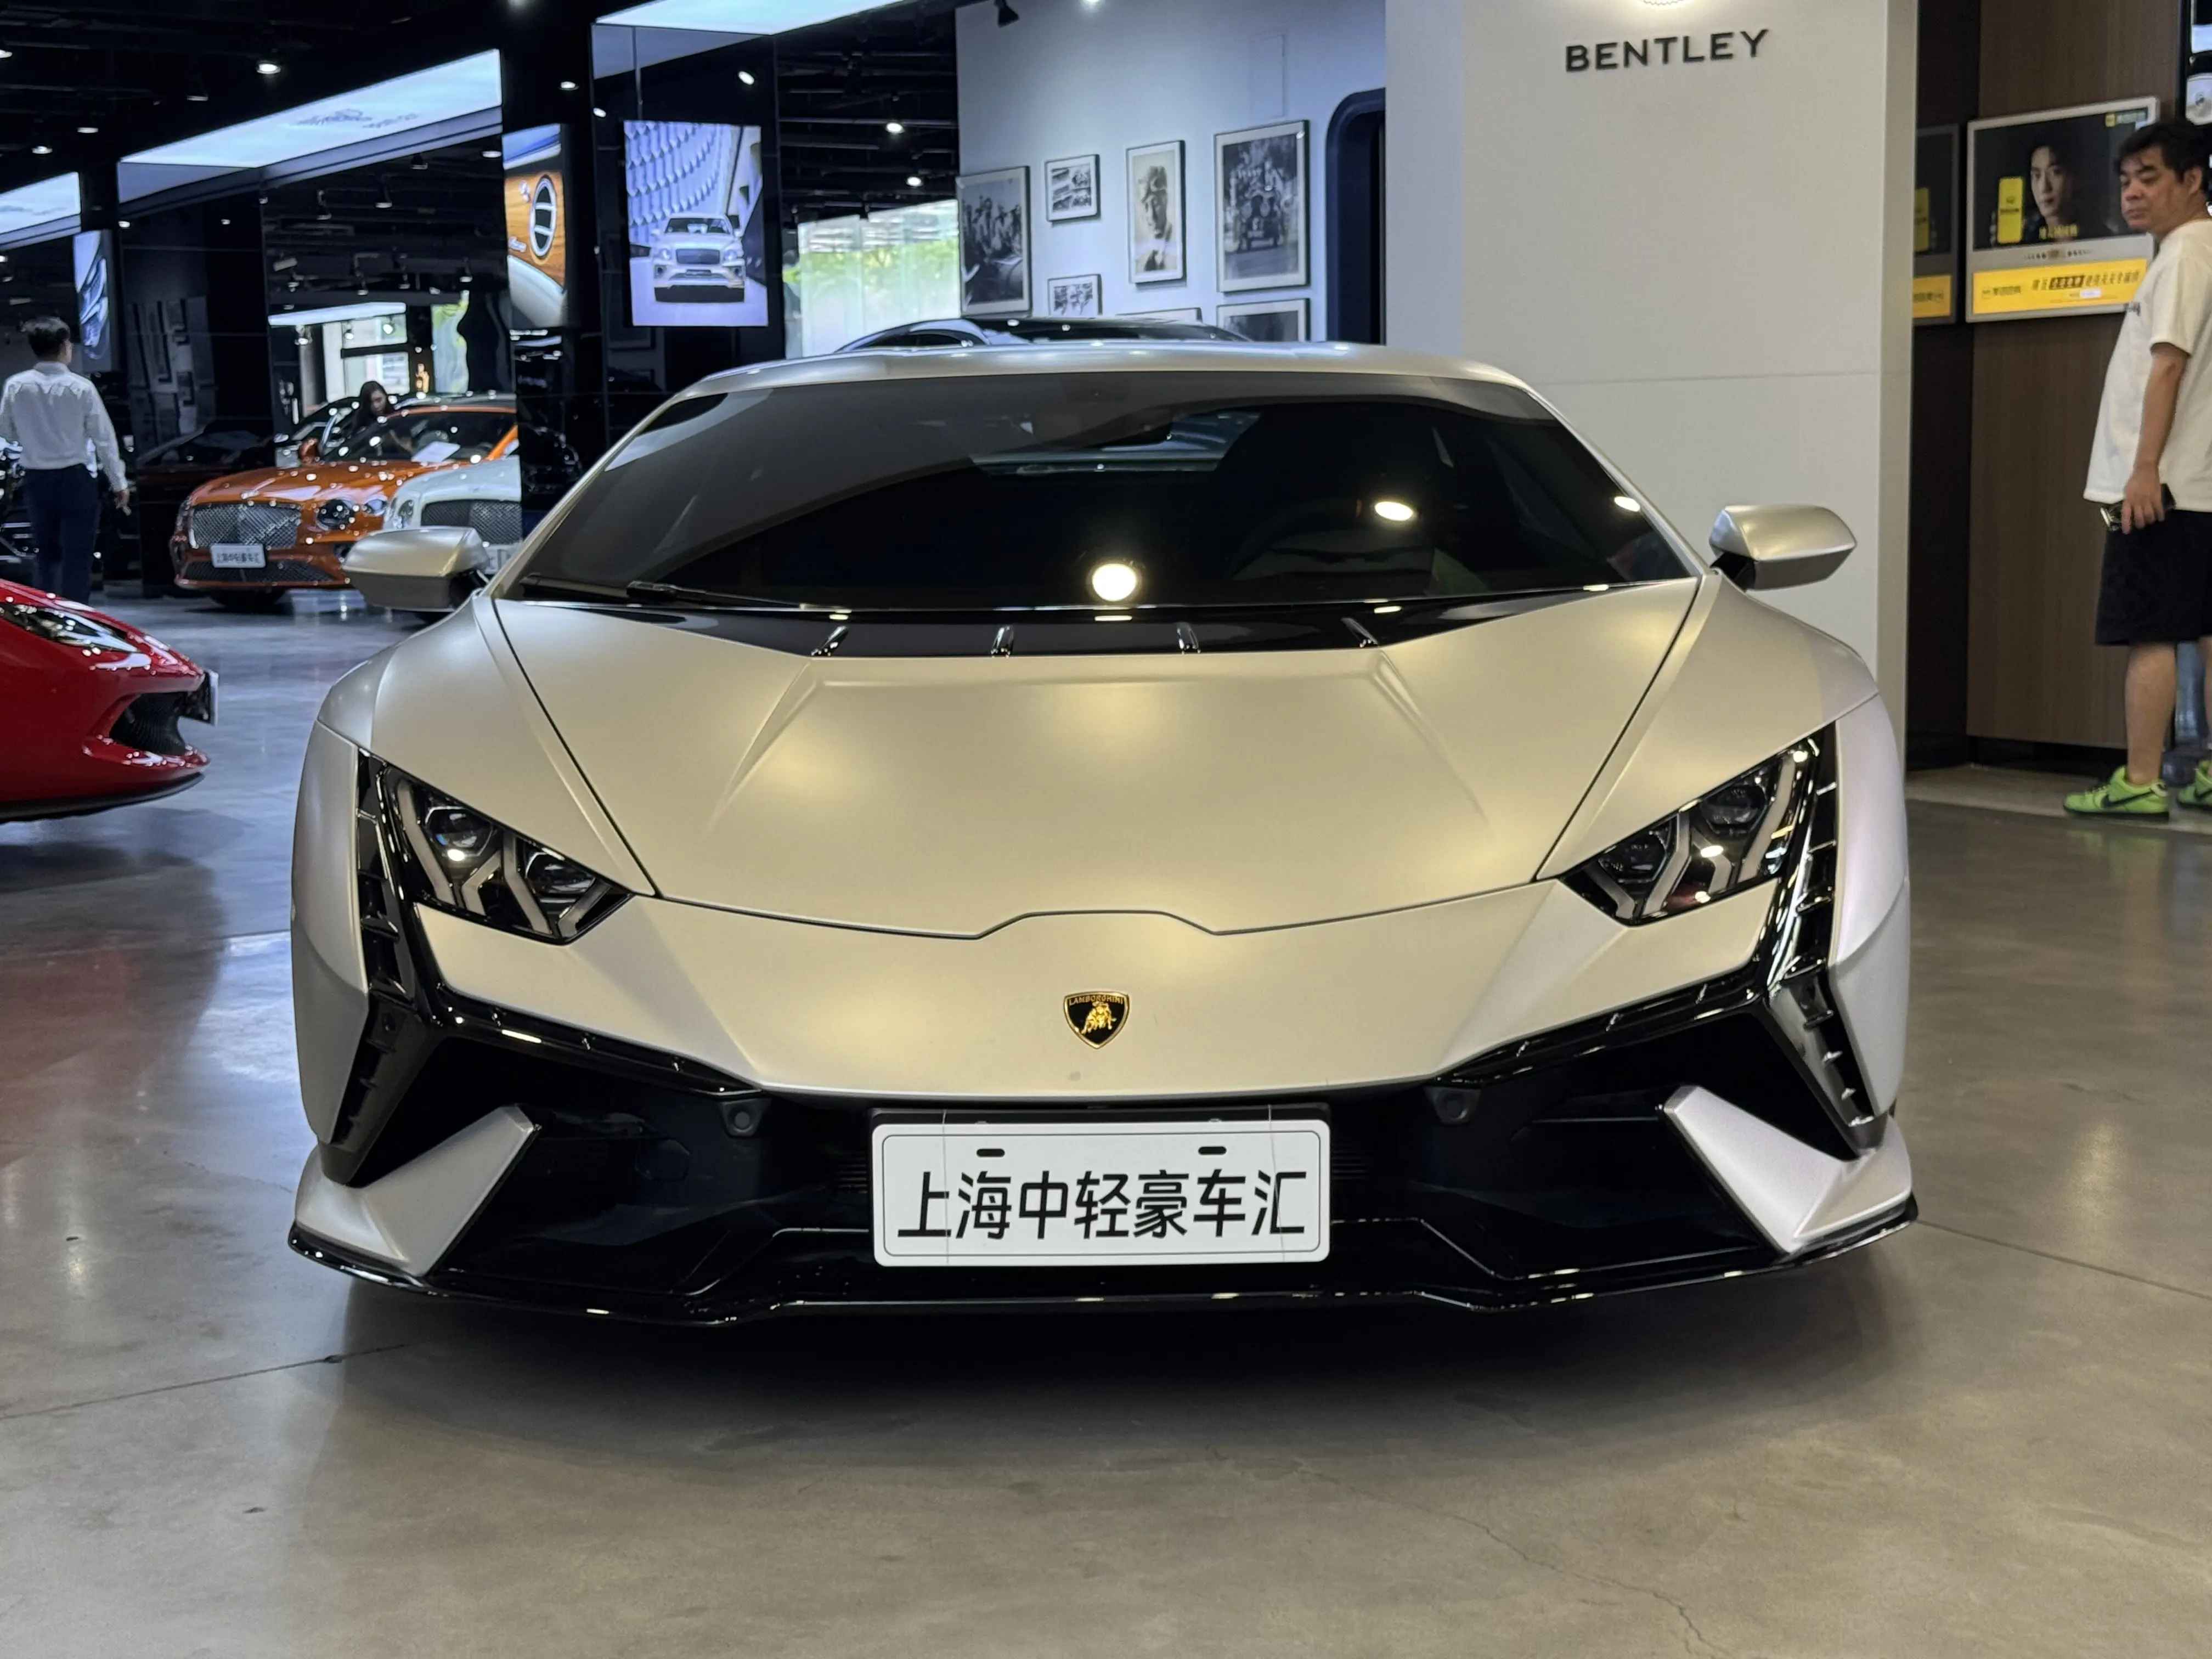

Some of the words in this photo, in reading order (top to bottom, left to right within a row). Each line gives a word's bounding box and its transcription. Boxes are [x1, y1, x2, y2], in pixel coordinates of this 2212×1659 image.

[1566, 29, 1769, 72] BENTLEY
[1069, 995, 1124, 1006] LAMBORGHINI
[897, 1169, 1307, 1240] 上海中轻豪车汇
